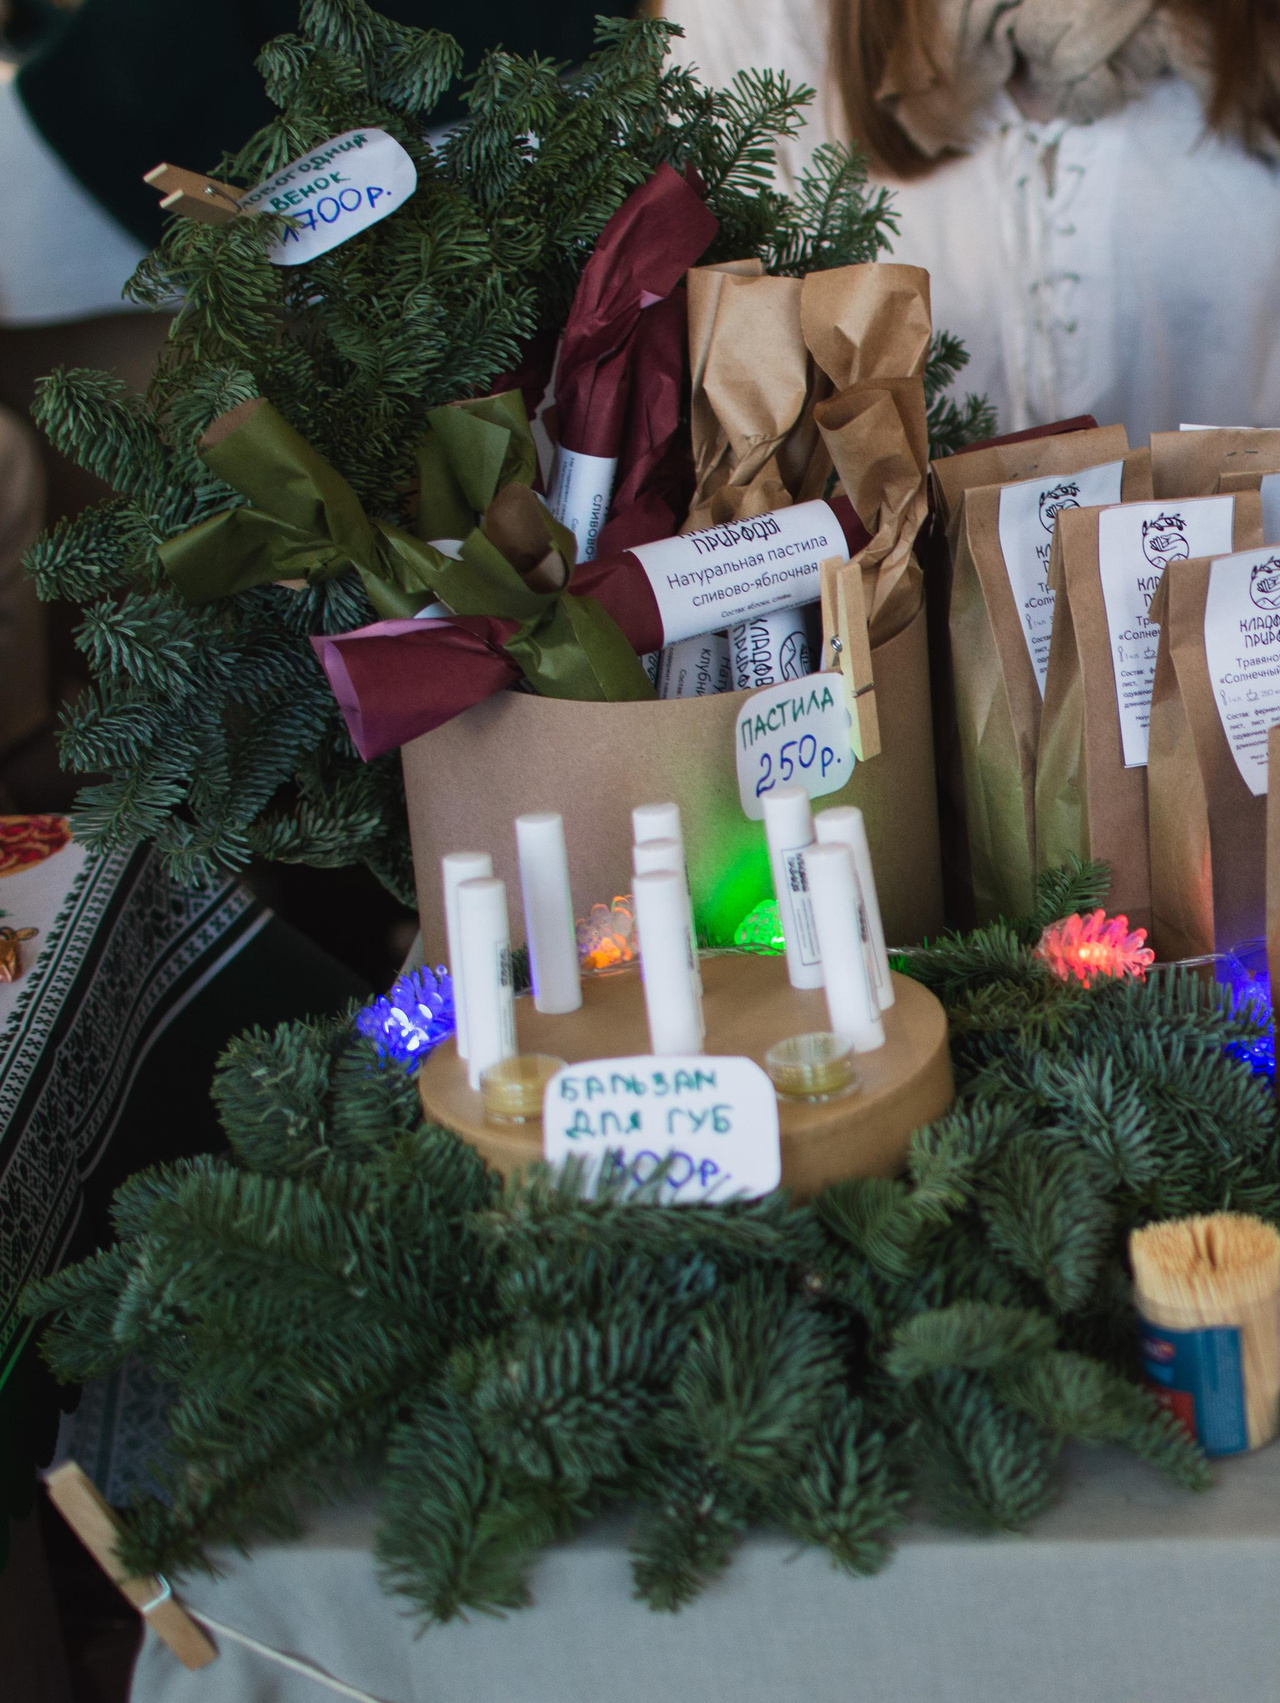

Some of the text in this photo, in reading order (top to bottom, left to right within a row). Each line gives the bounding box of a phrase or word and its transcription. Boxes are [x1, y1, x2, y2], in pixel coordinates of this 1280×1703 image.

[269, 171, 352, 211] ВЕНОК
[691, 518, 781, 554] ПРИРОДЫ
[667, 535, 828, 589] Натуральная пастила
[692, 562, 819, 607] сливово-яблочная
[741, 687, 834, 751] ПАСТИЛА
[756, 734, 842, 798] 250р.
[560, 1070, 717, 1102] БАЛЬЗАМ
[565, 1103, 734, 1139] ДЛЯ ГУБ
